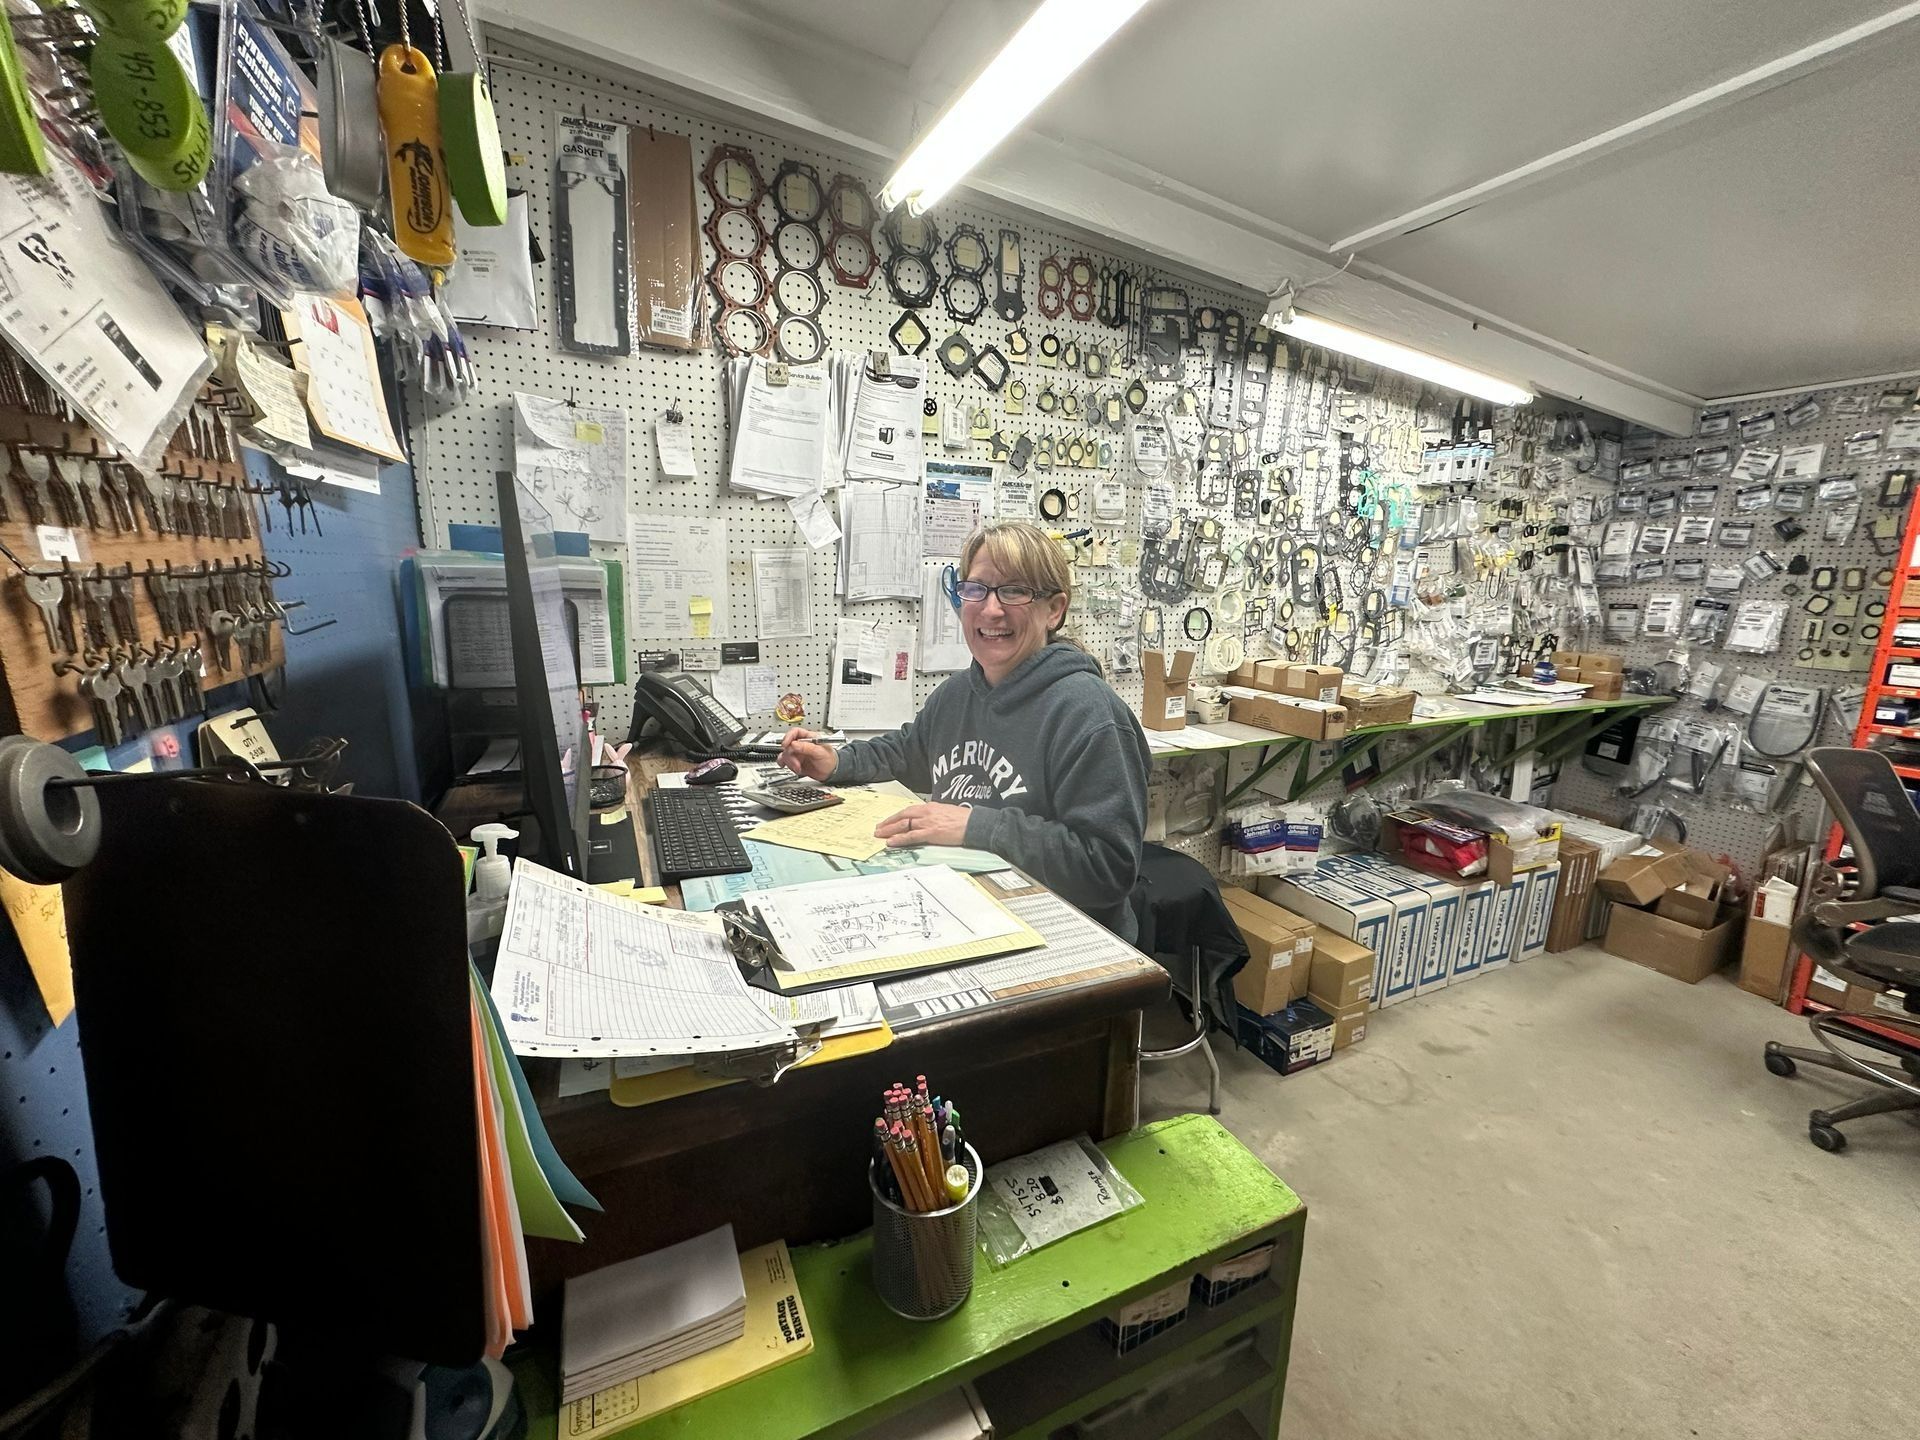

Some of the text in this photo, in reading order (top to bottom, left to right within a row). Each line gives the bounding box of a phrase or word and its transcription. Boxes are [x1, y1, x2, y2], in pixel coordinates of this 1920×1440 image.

[237, 45, 282, 108] Johnson
[238, 23, 283, 92] EVINRUDE
[237, 59, 297, 138] GENUINE PARTS
[562, 144, 604, 158] GASKET
[932, 740, 1028, 800] MERCURY
[941, 774, 992, 800] Marine
[1495, 898, 1507, 937] SUZUKI
[1532, 887, 1543, 925] SUZUKI
[1396, 925, 1408, 967] SUZUKI
[1430, 915, 1442, 957] SUZUKI
[1464, 907, 1475, 948] SUZUKI
[1026, 1177, 1046, 1202] 8.20
[777, 1300, 794, 1344] PORTAGE
[786, 1295, 805, 1341] PRINTING
